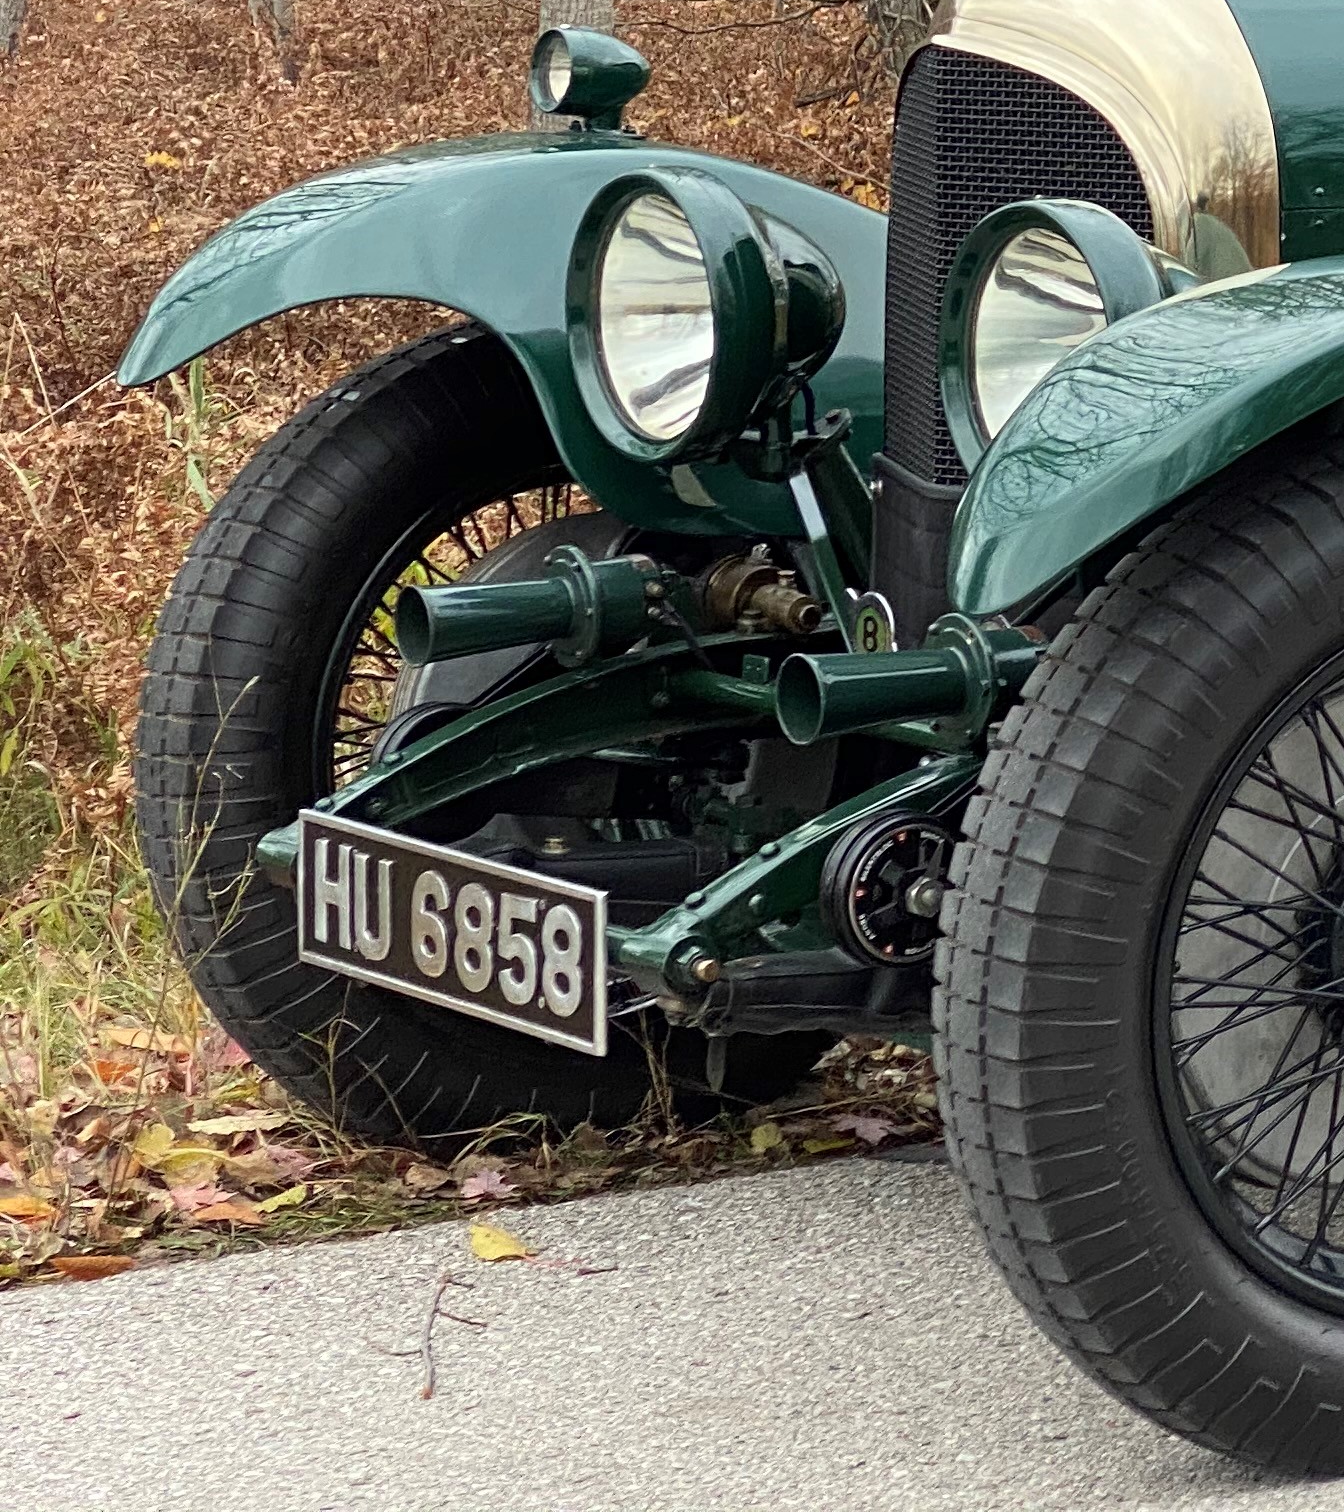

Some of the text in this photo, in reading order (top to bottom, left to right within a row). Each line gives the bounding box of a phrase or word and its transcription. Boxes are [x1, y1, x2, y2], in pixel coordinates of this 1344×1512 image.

[863, 616, 878, 653] 8
[314, 837, 583, 1018] HU 6858
